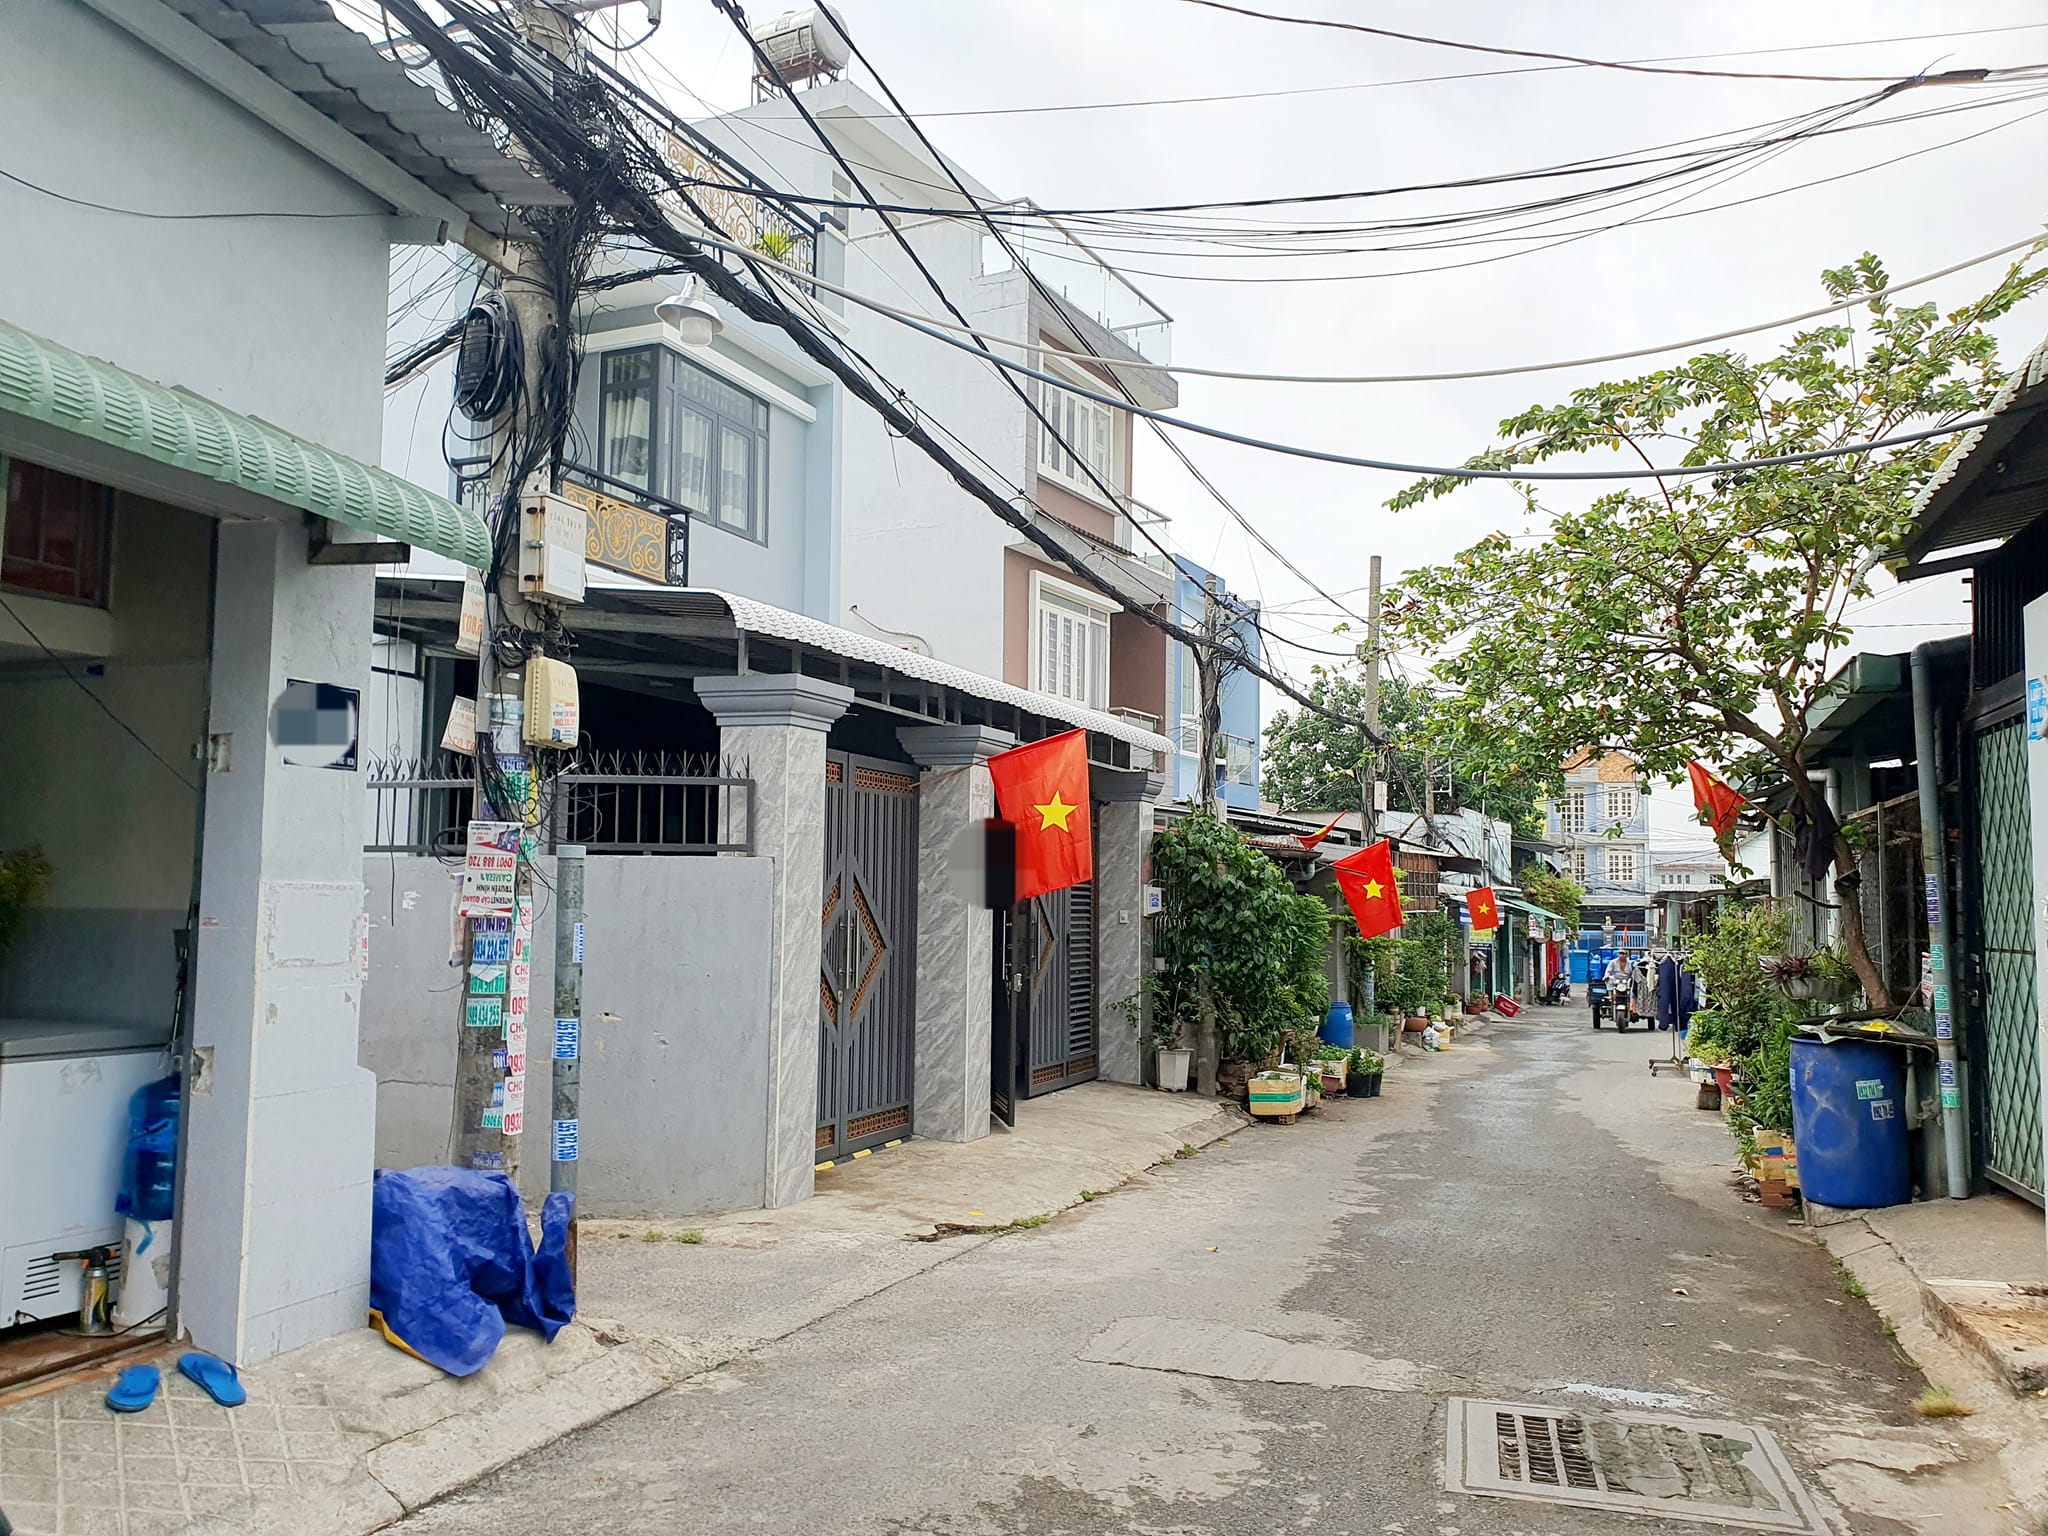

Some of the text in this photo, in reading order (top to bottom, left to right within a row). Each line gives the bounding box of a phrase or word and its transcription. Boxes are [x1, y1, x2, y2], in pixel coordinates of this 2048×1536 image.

[468, 855, 481, 867] 720
[496, 856, 513, 868] 0901
[485, 873, 513, 883] CAMERA
[490, 896, 513, 905] INTERNET
